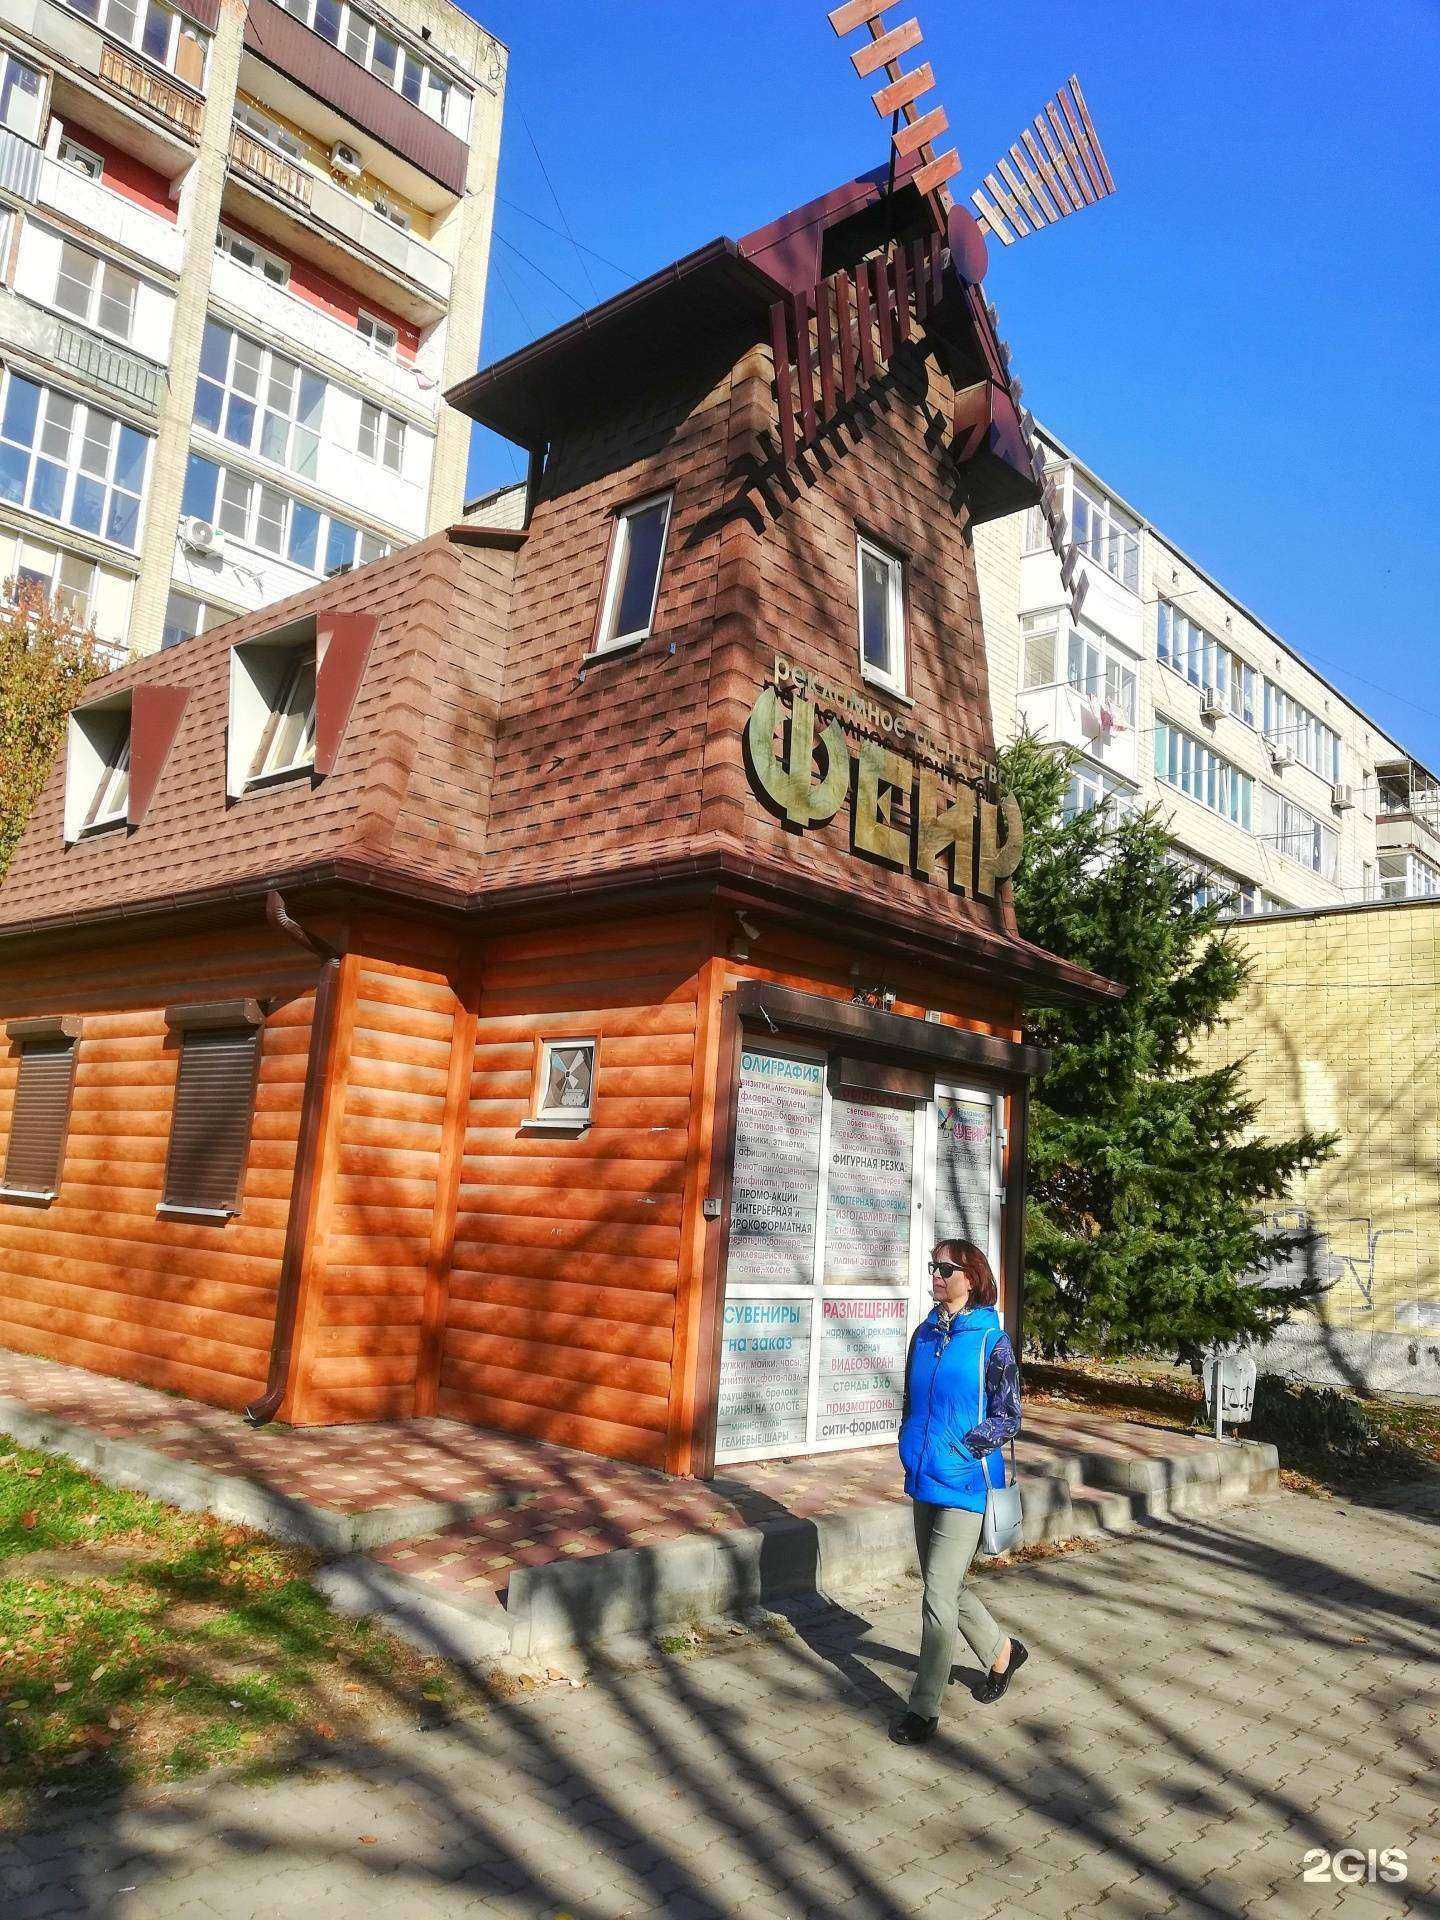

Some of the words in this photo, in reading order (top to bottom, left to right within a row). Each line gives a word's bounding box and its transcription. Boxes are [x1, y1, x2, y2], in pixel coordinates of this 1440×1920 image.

[741, 1055, 820, 1082] ОЛИГРАФИЯ
[736, 1106, 775, 1119] алендари,
[832, 1153, 878, 1169] ФИГУРНАЯ
[736, 1202, 793, 1217] ИНТЕРЬЕРНАЯ
[731, 1218, 812, 1234] ИРОКОФОРМАТНАЯ
[724, 1305, 801, 1324] СУВЕНИРЫ
[823, 1302, 905, 1320] РАЗМЕЩЕНИЕ
[728, 1340, 747, 1351] на
[752, 1336, 793, 1351] заказ
[831, 1357, 894, 1373] ВИДЕОЭКРАН
[833, 1380, 869, 1392] стенды
[719, 1404, 753, 1416] АРТИНЫ
[755, 1403, 767, 1413] НА
[822, 1418, 897, 1436] сити-форматы
